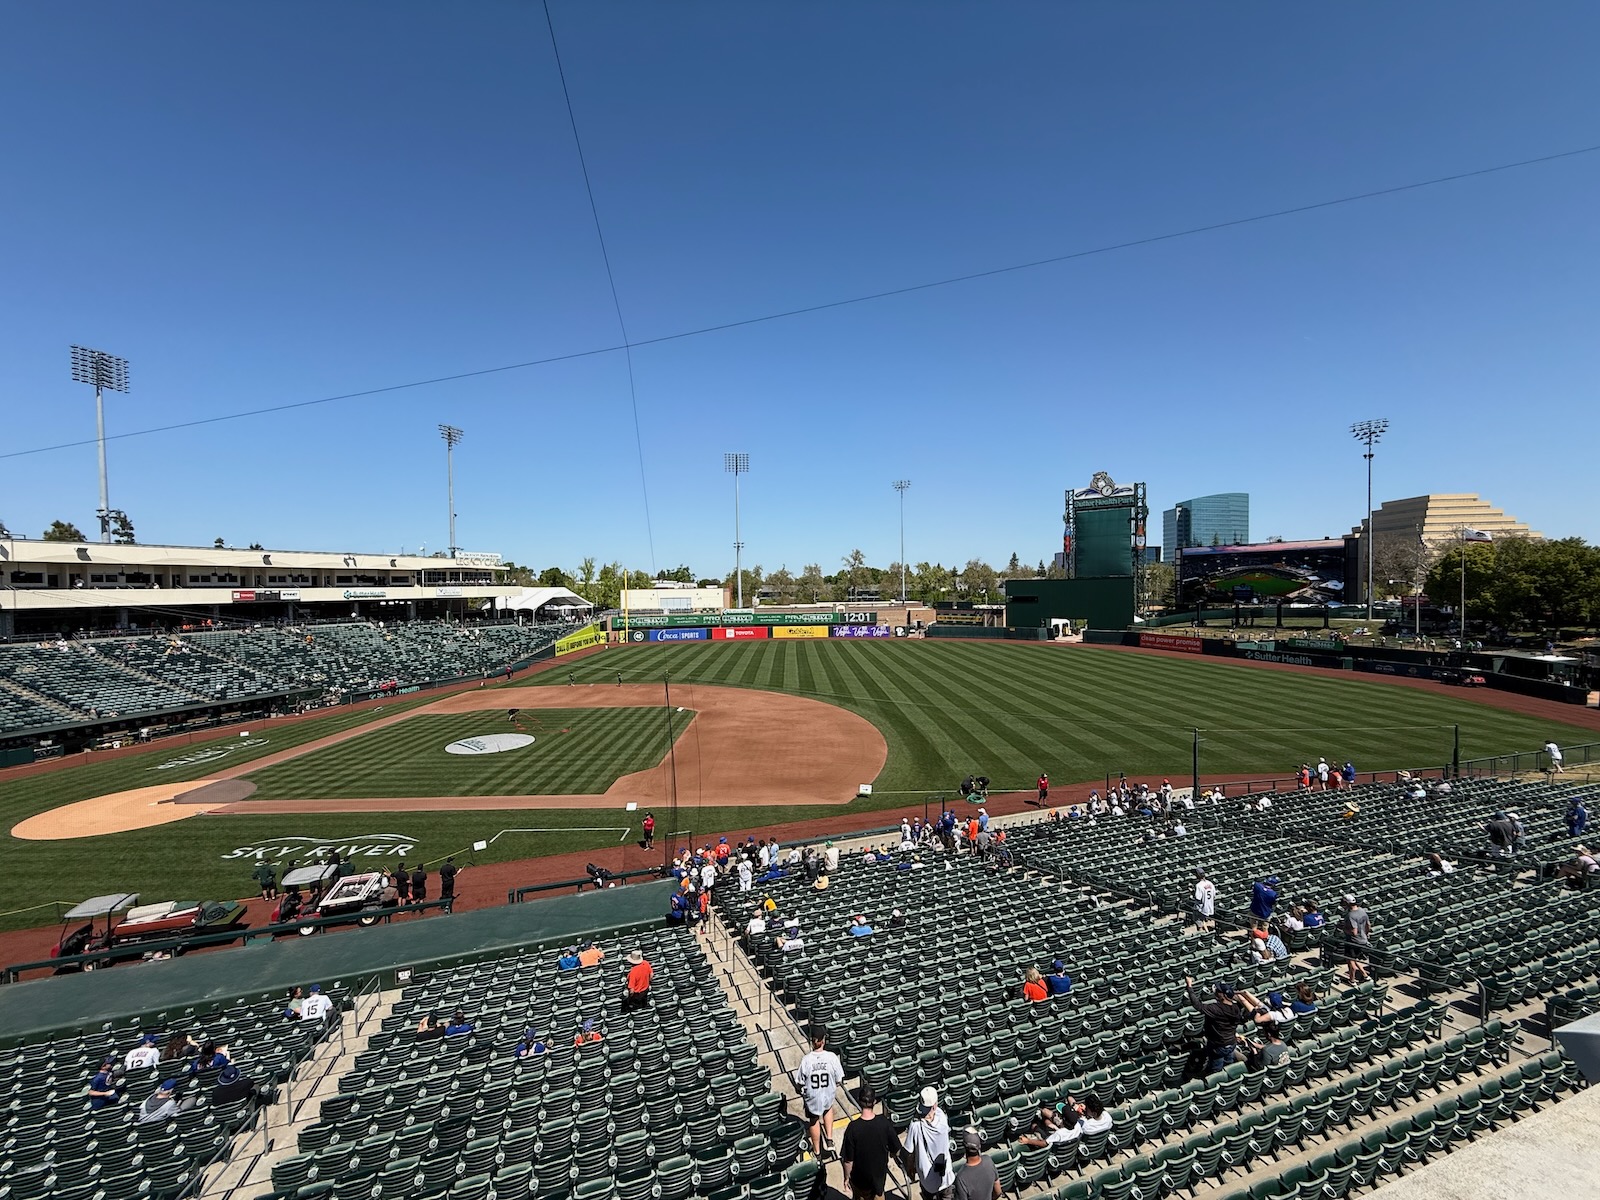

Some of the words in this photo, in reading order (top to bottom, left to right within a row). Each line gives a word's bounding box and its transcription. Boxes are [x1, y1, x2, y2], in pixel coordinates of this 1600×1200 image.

[456, 557, 484, 566] LEGACY
[844, 612, 871, 623] 12:01
[657, 629, 679, 642] Circa
[681, 631, 699, 640] SPORTS
[1156, 636, 1175, 645] power
[1175, 639, 1201, 647] promise
[1254, 651, 1281, 662] Sutter
[1281, 654, 1313, 666] Health
[398, 685, 420, 695] Health
[221, 845, 305, 859] SKY
[1206, 890, 1212, 900] 5
[307, 1004, 319, 1016] 15
[811, 1073, 829, 1089] 99
